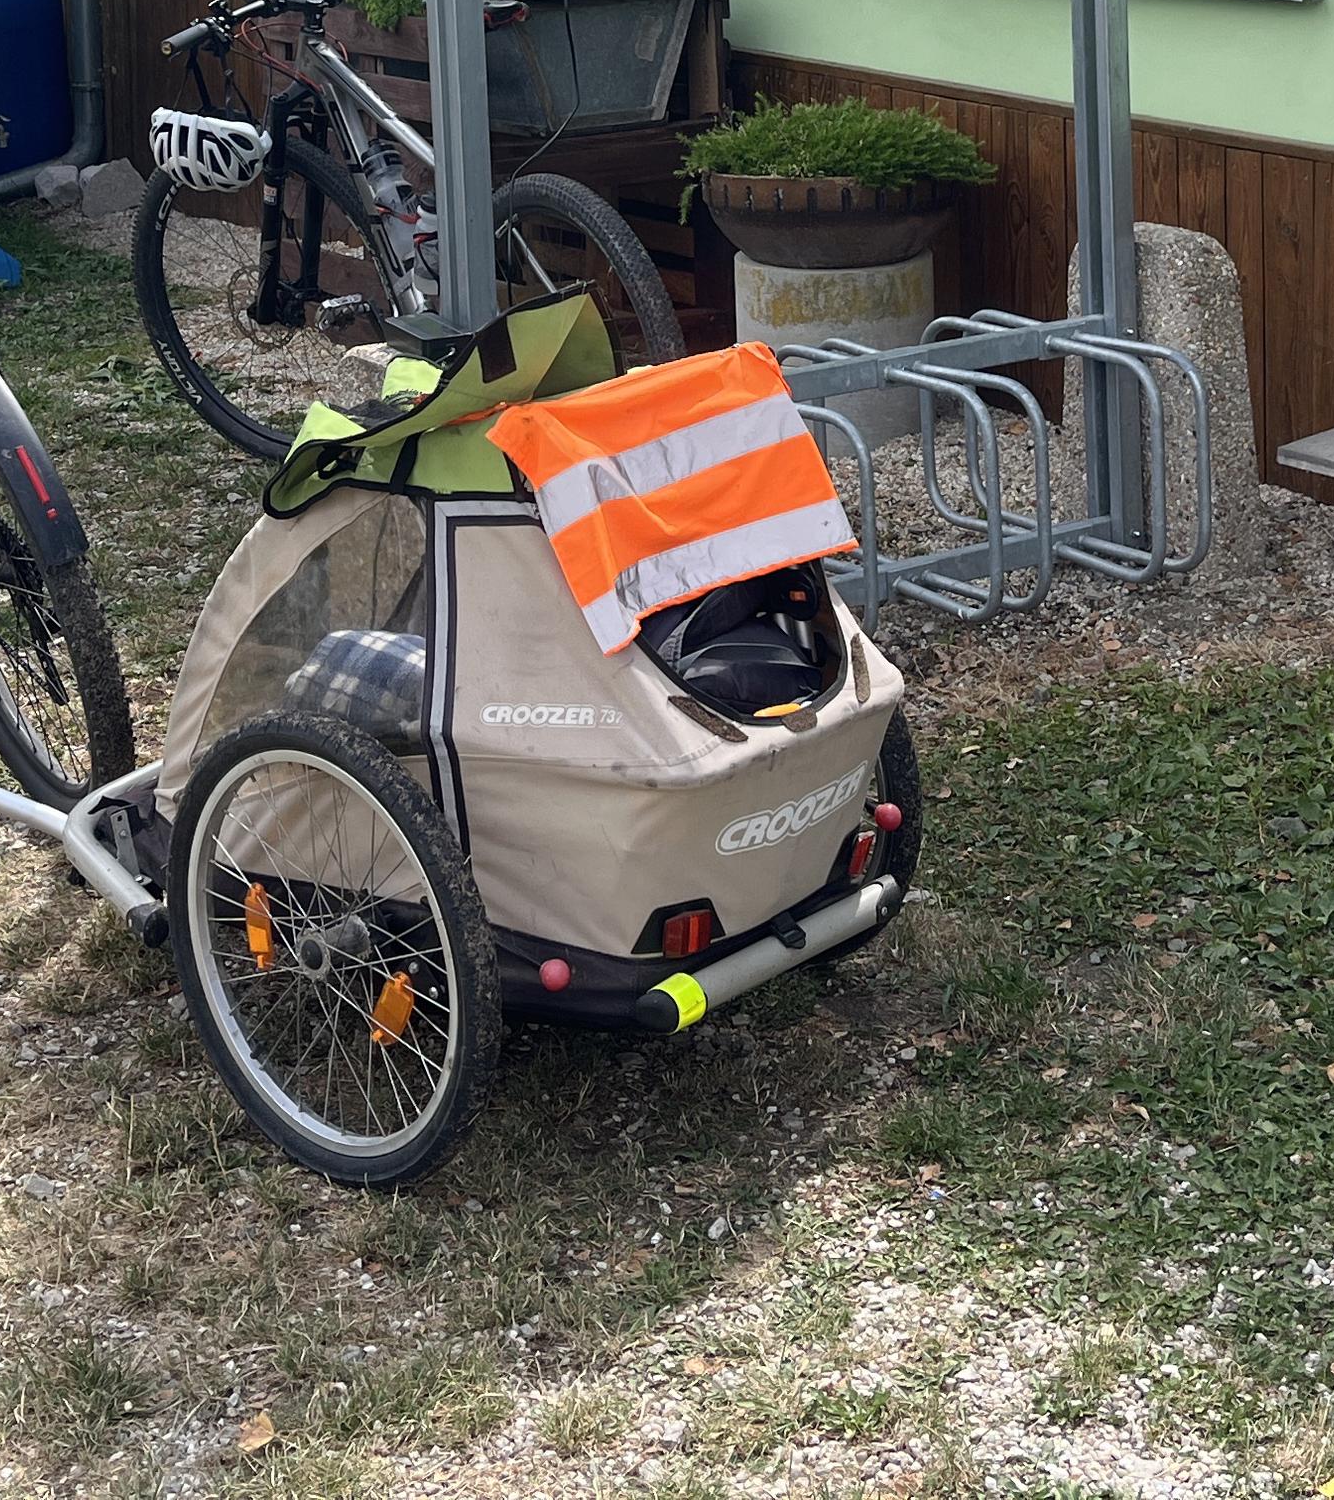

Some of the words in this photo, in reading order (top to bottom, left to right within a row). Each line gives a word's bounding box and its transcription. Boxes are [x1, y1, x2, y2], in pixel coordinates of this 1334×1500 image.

[156, 339, 203, 405] VICTORY
[481, 704, 596, 726] CROOZER
[719, 763, 867, 851] CROOZER
